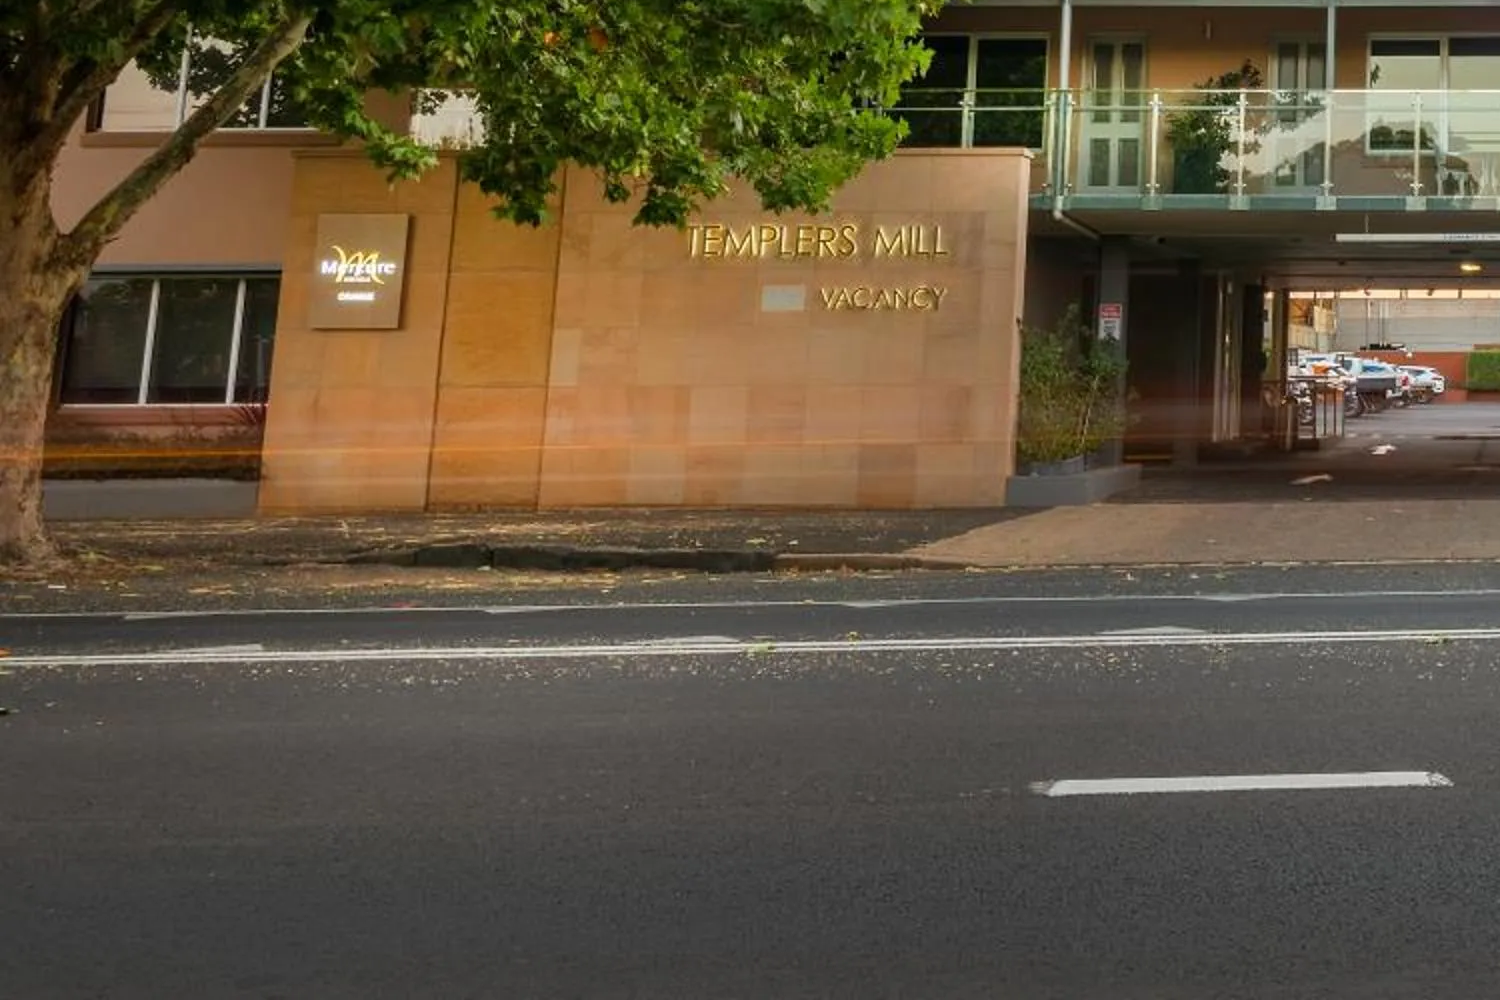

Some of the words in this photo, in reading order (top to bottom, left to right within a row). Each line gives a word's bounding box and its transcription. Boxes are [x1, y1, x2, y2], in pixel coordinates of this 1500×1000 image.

[688, 223, 857, 258] TEMPLERS
[873, 224, 949, 257] MILL
[820, 286, 948, 311] VACANCY
